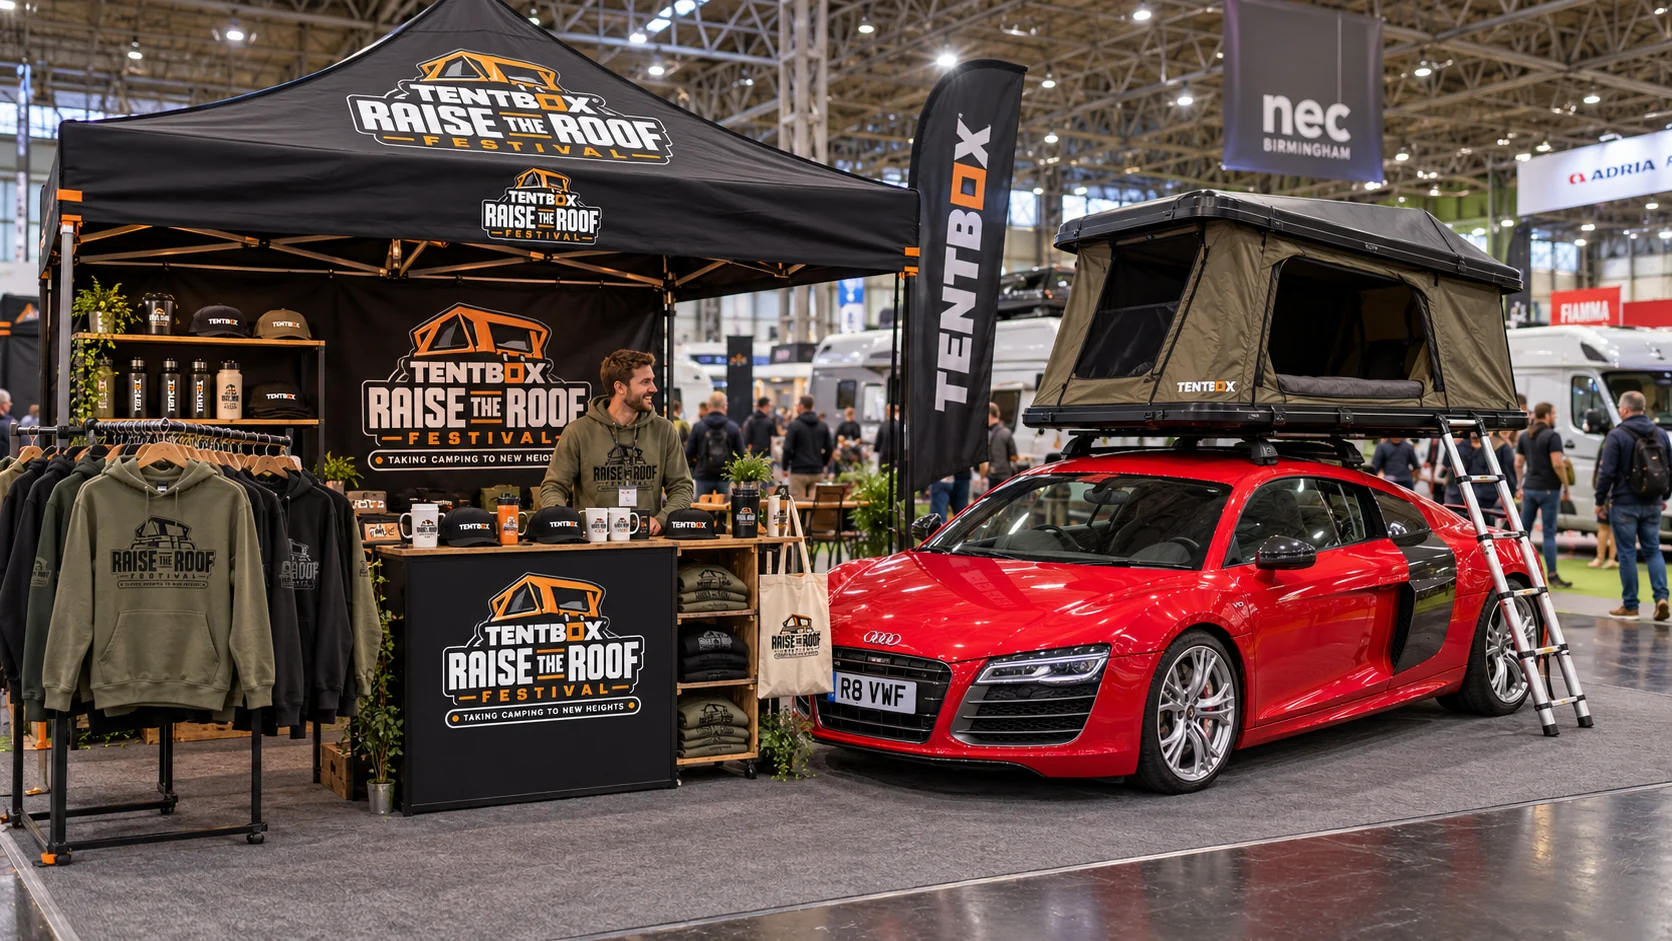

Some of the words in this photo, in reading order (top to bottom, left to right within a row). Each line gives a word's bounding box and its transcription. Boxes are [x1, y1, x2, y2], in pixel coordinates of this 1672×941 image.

[410, 84, 591, 115] TENTBOX
[356, 98, 504, 139] RAISE
[503, 115, 548, 135] THE
[549, 113, 660, 151] ROOF
[1263, 94, 1351, 142] nec
[424, 135, 628, 159] FESTIVAL
[1263, 137, 1351, 160] BIRMINGHAM
[1591, 159, 1656, 181] ADRIA
[508, 190, 577, 207] TENTBOX
[485, 203, 536, 229] RAISE
[538, 212, 554, 224] THE
[556, 207, 599, 234] ROOF
[505, 229, 580, 241] FESTIVAL
[934, 116, 991, 412] TENTBOX
[1560, 300, 1610, 323] FIAMMA
[409, 360, 547, 384] TENTBOX
[368, 387, 466, 429] RAISE
[470, 397, 502, 417] THE
[506, 387, 586, 428] ROOF
[408, 431, 552, 445] FESTIVAL
[388, 455, 427, 464] TAKING
[431, 455, 478, 464] CAMPING
[482, 454, 496, 463] TO
[500, 454, 522, 463] NEW
[593, 466, 623, 482] RAISE
[633, 464, 658, 481] ROOF
[112, 550, 157, 573] RAISE
[159, 555, 173, 566] THE
[174, 551, 215, 573] ROOF
[484, 620, 604, 646] TENTBOX
[771, 635, 796, 650] RAISE
[448, 648, 534, 691] RAISE
[537, 654, 564, 674] THE
[568, 641, 639, 682] ROOF
[481, 683, 609, 703] FESTIVAL
[840, 677, 863, 701] R8
[868, 681, 906, 707] VWF
[463, 712, 498, 721] TAKING
[501, 708, 544, 719] CAMPING
[547, 707, 559, 716] TO
[562, 705, 583, 714] NEW
[586, 703, 624, 713] HEIGHTS
